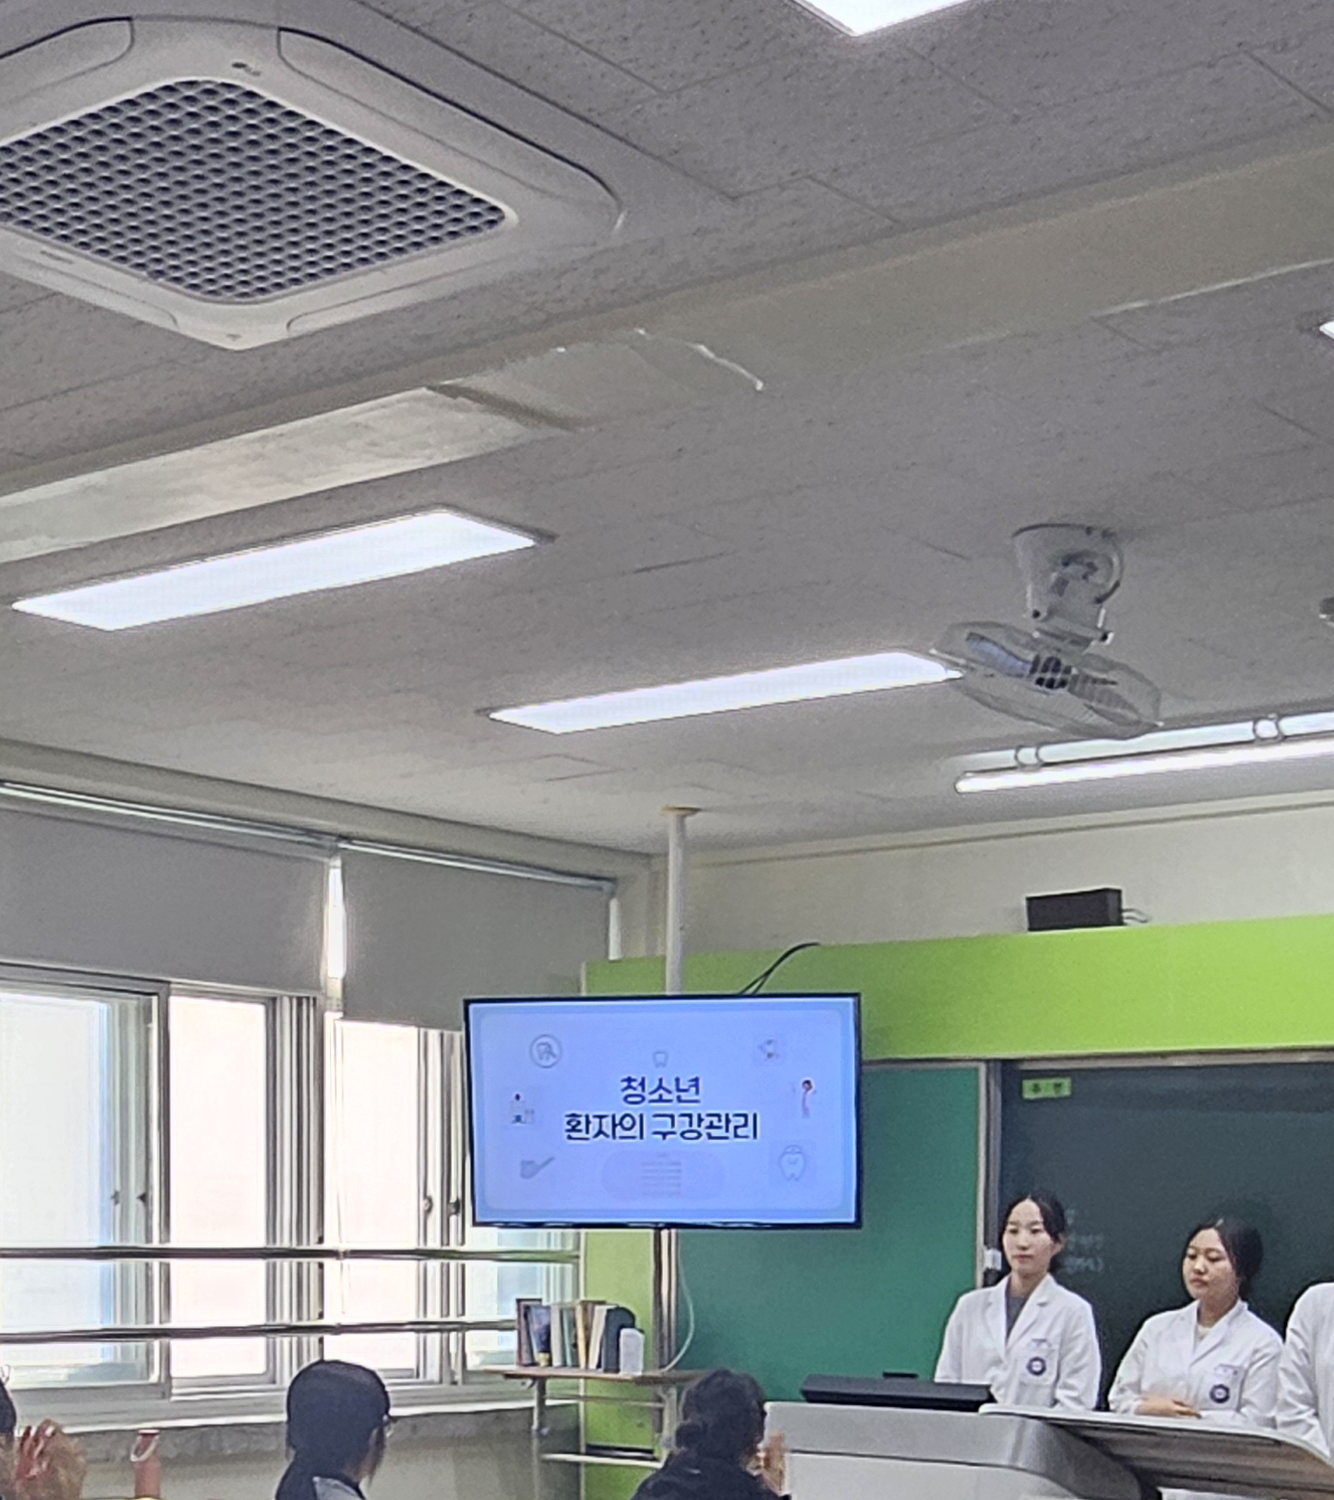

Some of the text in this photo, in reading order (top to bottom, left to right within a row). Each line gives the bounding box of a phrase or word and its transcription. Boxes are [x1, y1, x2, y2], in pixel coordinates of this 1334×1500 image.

[620, 1076, 701, 1105] 청소년
[564, 1112, 758, 1141] 환자의 구강관리
